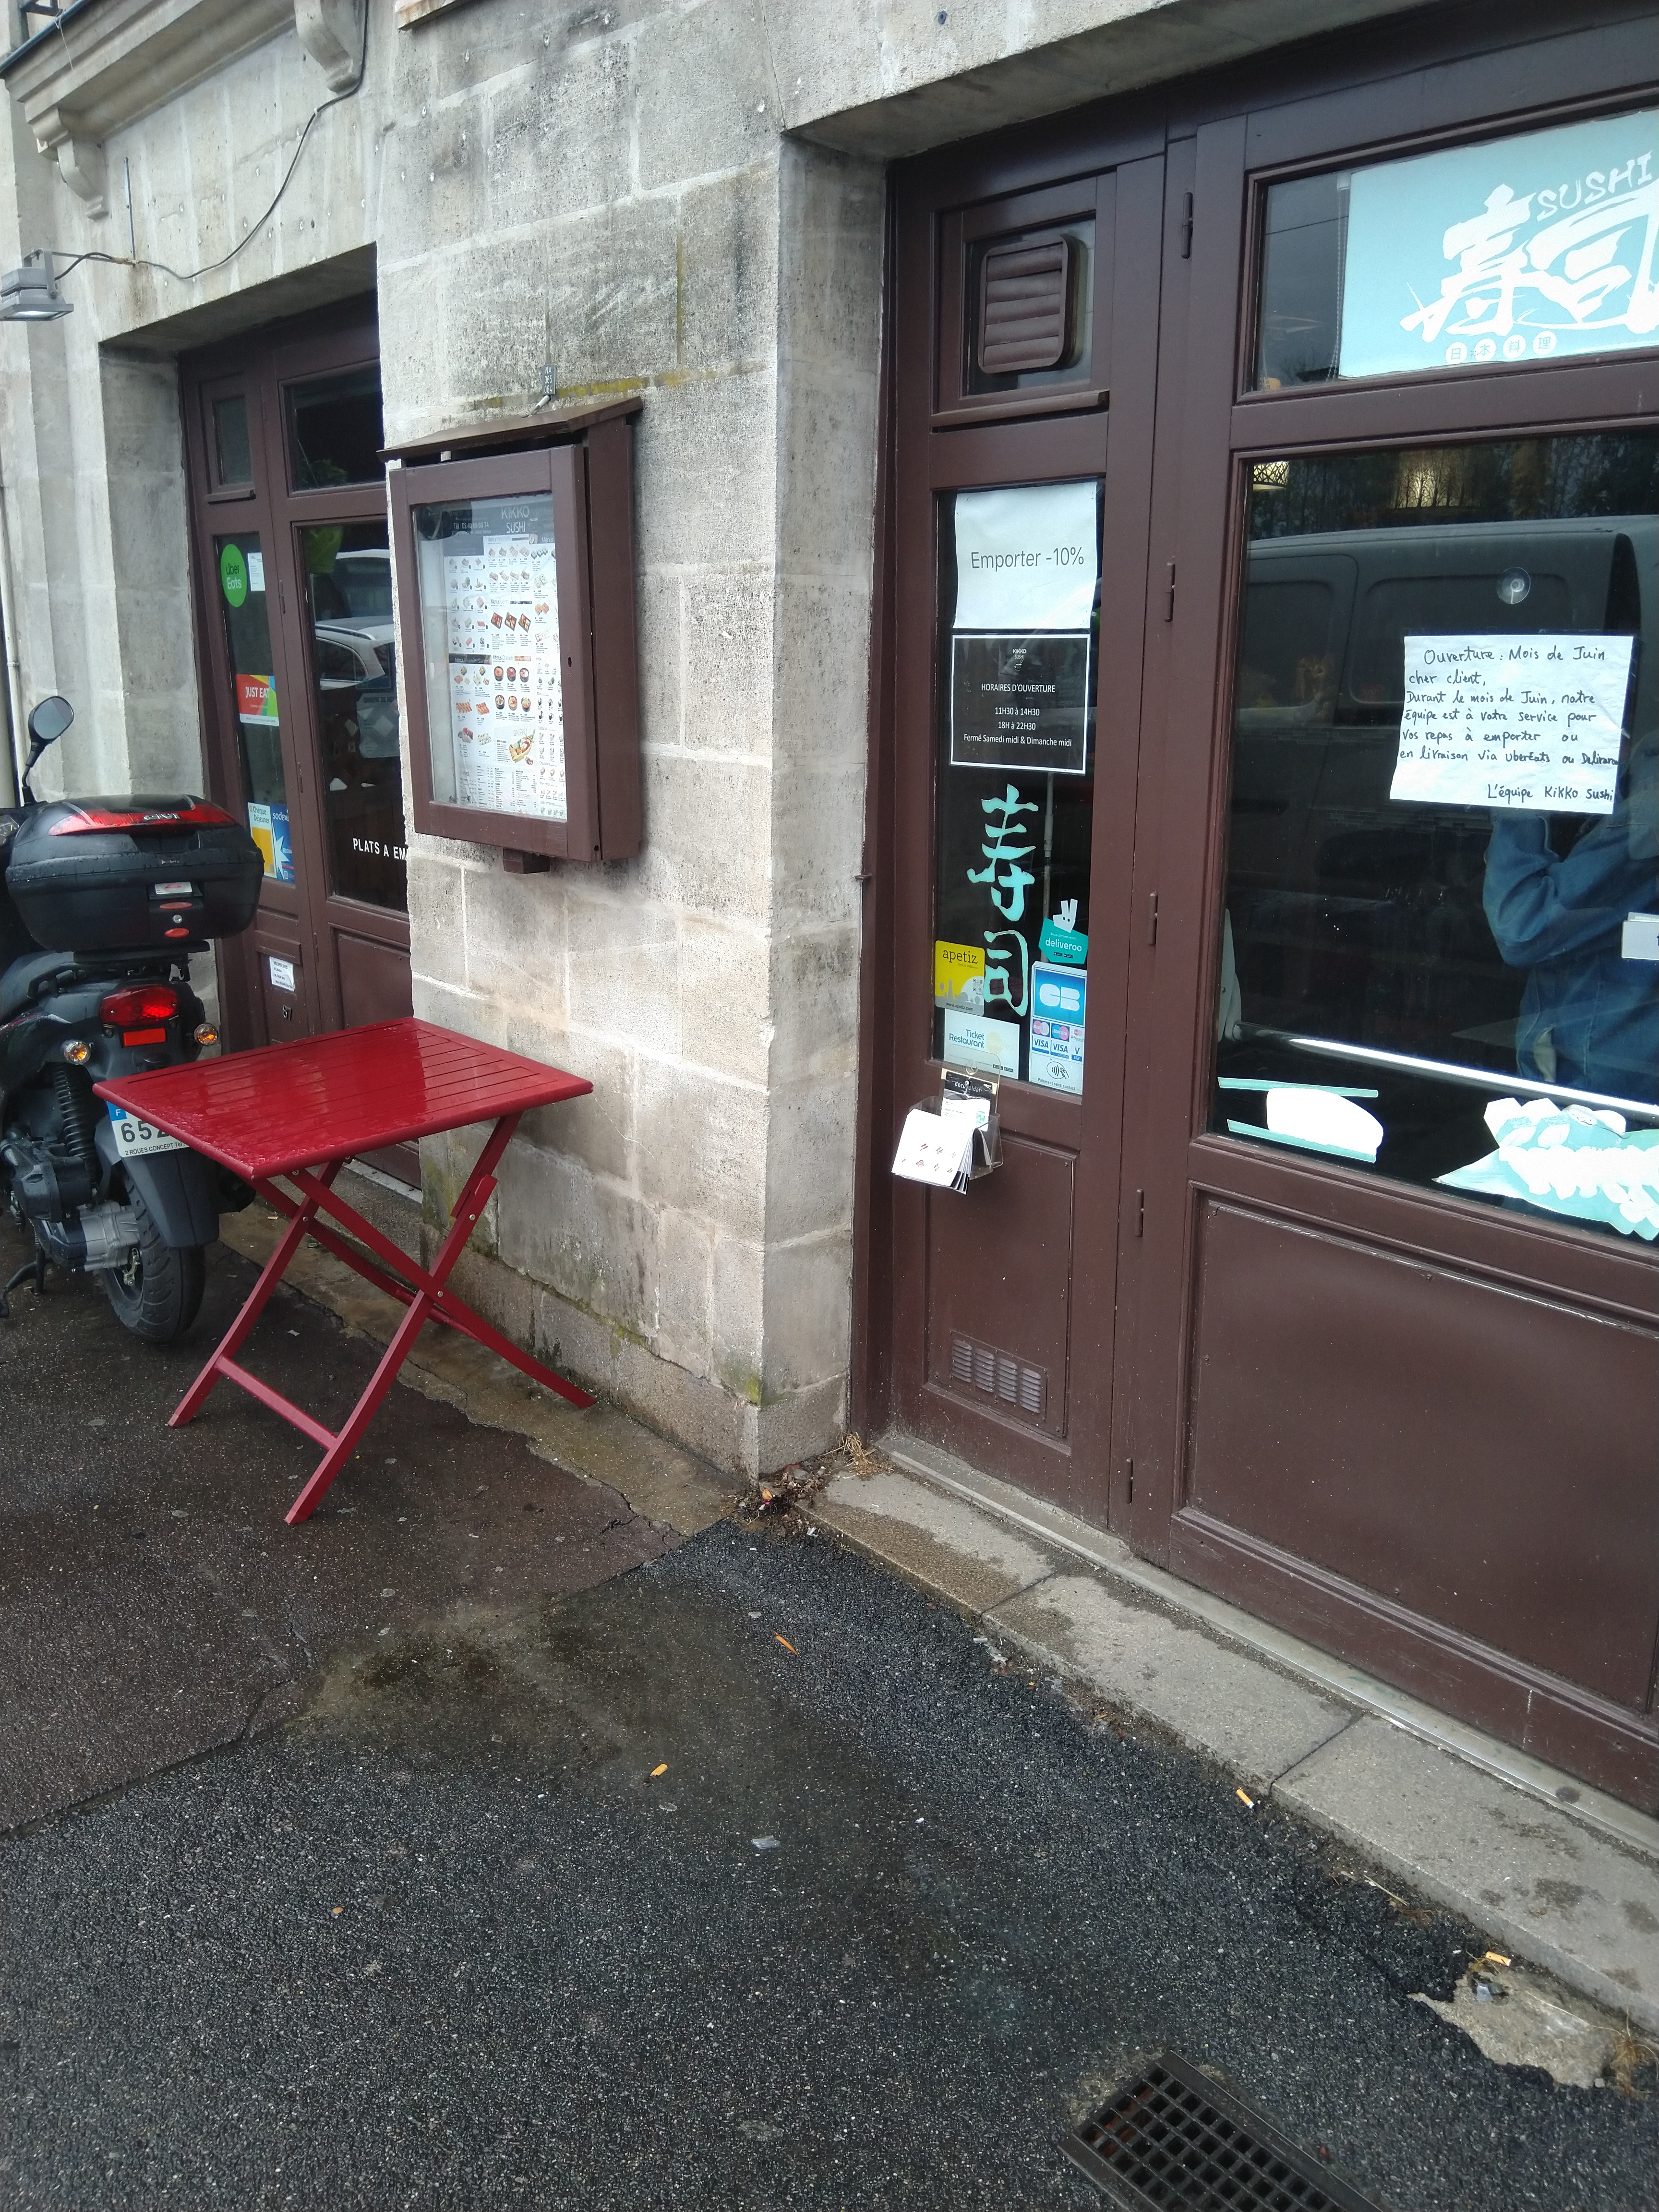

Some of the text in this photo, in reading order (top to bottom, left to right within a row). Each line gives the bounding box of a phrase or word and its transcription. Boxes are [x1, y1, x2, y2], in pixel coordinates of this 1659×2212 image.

[1537, 150, 1652, 221] SUSHI
[1449, 335, 1553, 362] 日本料理
[501, 505, 529, 519] KIKKO
[506, 521, 526, 533] SUSHI
[971, 547, 1084, 572] Emporter -10%
[225, 563, 240, 575] Uber
[227, 577, 241, 589] Eats
[1509, 645, 1539, 661] Mois
[1547, 645, 1563, 661] de
[1573, 646, 1605, 661] Juin
[1409, 669, 1485, 686] cher client,
[245, 686, 270, 698] JUST EAT
[1012, 684, 1056, 693] D'OUVERTURE
[1407, 690, 1446, 703] Durant
[1453, 689, 1465, 703] le
[1470, 692, 1494, 703] mois
[1500, 687, 1514, 702] de
[1561, 690, 1595, 704] notre
[1404, 709, 1438, 725] équipe
[1443, 708, 1460, 720] est
[1466, 708, 1474, 720] à
[1518, 710, 1558, 722] service
[1567, 712, 1597, 728] pour
[983, 734, 1004, 743] Samedi
[1006, 735, 1019, 744] midi
[1020, 736, 1025, 744] &
[1027, 737, 1057, 746] Dimanche
[1425, 732, 1453, 745] repas
[1465, 727, 1473, 742] à
[1562, 733, 1578, 742] ou
[1562, 755, 1574, 764] ou
[1488, 783, 1533, 805] L'équipe
[1586, 788, 1614, 801] Sushi
[252, 806, 267, 816] Chèque
[253, 814, 270, 824] Déjeuner
[353, 838, 380, 854] PLATS
[384, 844, 389, 857] A
[966, 783, 1039, 1016] 寿司
[1045, 938, 1082, 952] deliveroo
[943, 950, 978, 964] apetiz
[946, 1002, 974, 1011] www.apetiz.com
[949, 1033, 985, 1048] Restaurant
[965, 1029, 985, 1040] Ticket
[1034, 1039, 1049, 1048] VISA
[1053, 1043, 1068, 1053] VISA
[1075, 1046, 1080, 1055] V
[1038, 1077, 1053, 1085] Paiement
[115, 1108, 121, 1117] F
[149, 1142, 173, 1152] CONCEPT
